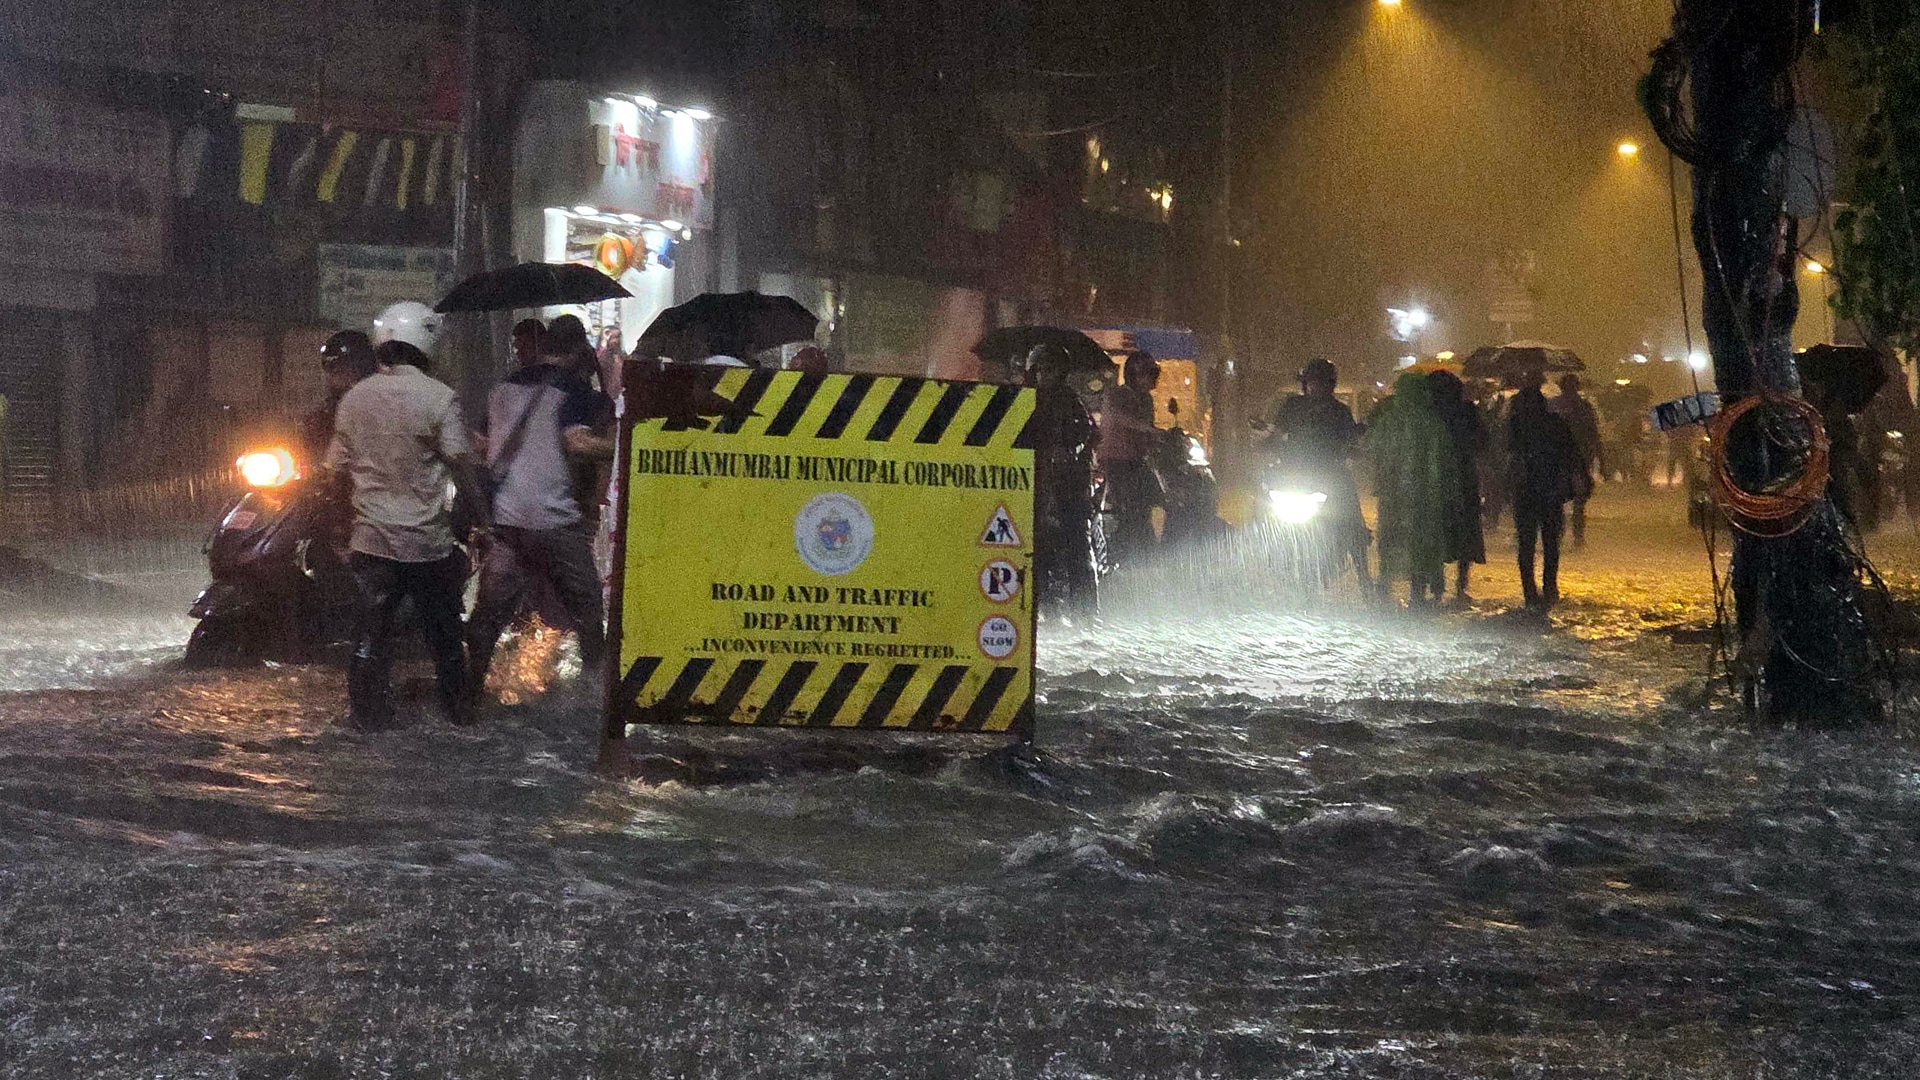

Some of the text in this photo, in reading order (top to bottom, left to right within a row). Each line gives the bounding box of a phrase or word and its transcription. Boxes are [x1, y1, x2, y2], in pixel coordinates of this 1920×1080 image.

[637, 449, 1031, 491] BRIHANMUMBAI MUNICIPAL CORPORATION
[711, 583, 934, 607] ROAD AND TRAFFIC
[743, 612, 900, 634] DEPARTMENT
[991, 623, 1007, 632] GO
[982, 637, 1013, 646] SLOW
